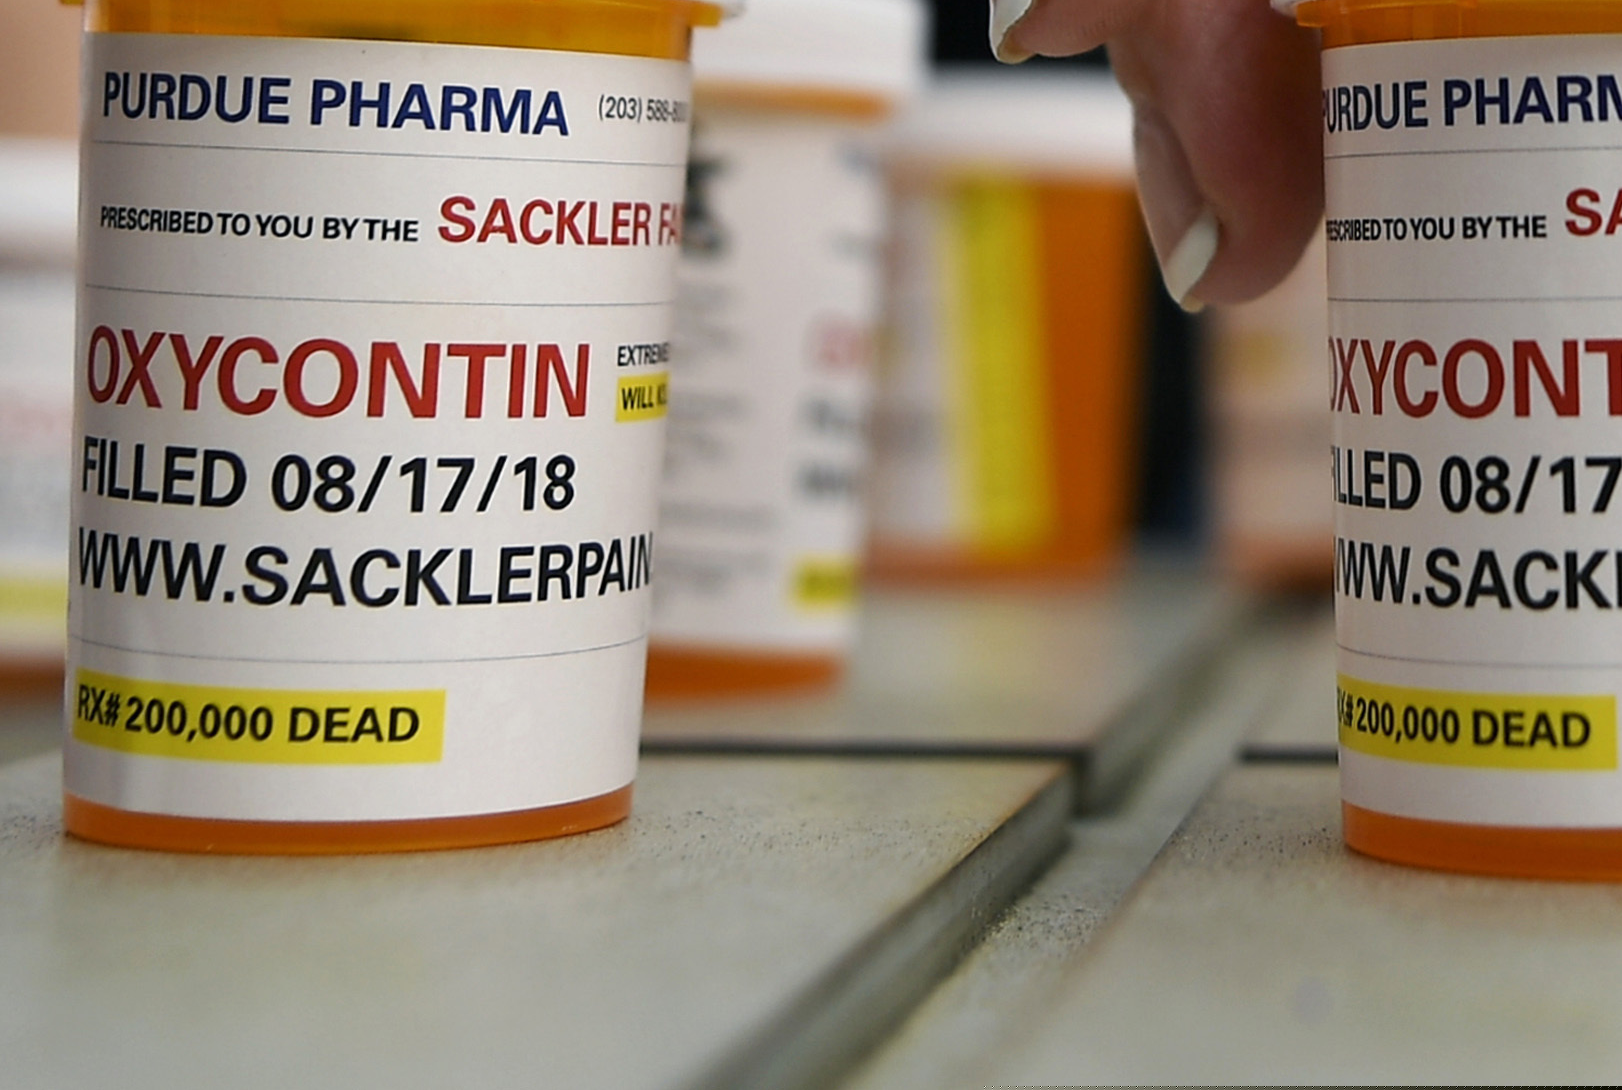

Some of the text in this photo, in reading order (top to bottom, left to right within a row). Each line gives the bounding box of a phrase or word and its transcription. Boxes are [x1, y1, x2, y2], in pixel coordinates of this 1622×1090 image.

[102, 70, 291, 125] PURDUE
[309, 78, 569, 137] PHARMA
[599, 94, 642, 123] (203)
[100, 205, 214, 235] PRESCRIBED
[216, 212, 251, 237] TO
[254, 214, 313, 239] YOU
[322, 216, 360, 241] BY
[362, 217, 419, 243] THE
[437, 194, 651, 247] SACKLER
[1383, 217, 1408, 241] TO
[1409, 215, 1454, 241] YOU
[1461, 215, 1492, 240] BY
[1496, 214, 1548, 239] THE
[86, 324, 590, 419] OXYCONTIN
[621, 385, 654, 411] WILL
[82, 434, 576, 514] FILLED 08/17/18
[77, 683, 421, 745] RX# 200,000 DEAD
[1356, 696, 1461, 746] 200,000
[1471, 709, 1592, 749] DEAD
